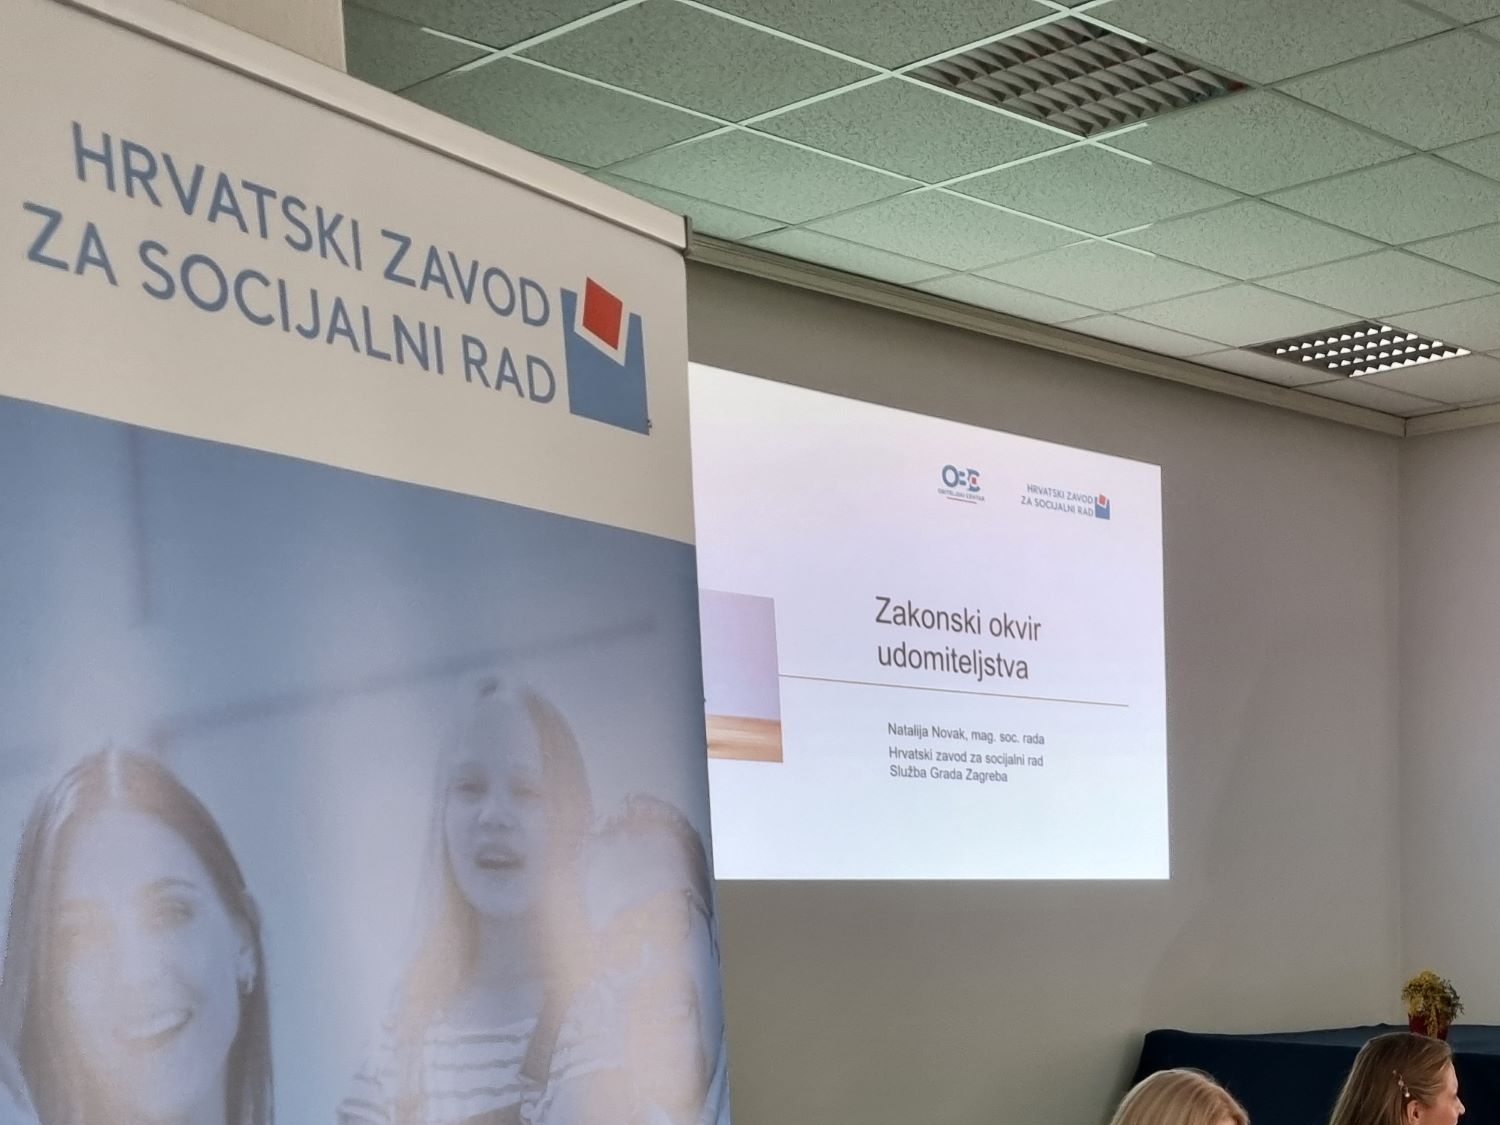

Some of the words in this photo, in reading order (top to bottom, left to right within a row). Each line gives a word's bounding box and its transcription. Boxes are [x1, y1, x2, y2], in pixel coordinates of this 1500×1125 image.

[72, 121, 362, 271] HRVATSKI
[381, 229, 551, 327] ZAVOD
[22, 201, 119, 286] ZA
[138, 240, 445, 375] SOCIJALNI
[462, 334, 557, 404] RAD
[1027, 484, 1065, 499] HRVATSKI
[1066, 492, 1094, 505] ZAVOD
[1020, 496, 1033, 507] ZA
[1034, 498, 1076, 513] SOCIJALNI
[1077, 506, 1094, 517] RAD
[875, 595, 982, 635] Zakonski
[989, 612, 1042, 641] okvir
[878, 641, 1029, 682] udomiteljstva
[888, 722, 929, 740] Natalija
[932, 725, 969, 742] Novak,
[971, 730, 996, 745] mag.
[999, 732, 1020, 743] soc.
[1022, 732, 1045, 745] rada
[888, 746, 933, 761] Hrvatski
[936, 750, 967, 763] zavod
[970, 753, 982, 764] za
[985, 752, 1025, 767] socijalni
[1028, 755, 1044, 767] rad
[889, 764, 927, 779] Služba
[930, 766, 963, 781] Grada
[966, 768, 1008, 784] Zagreba
